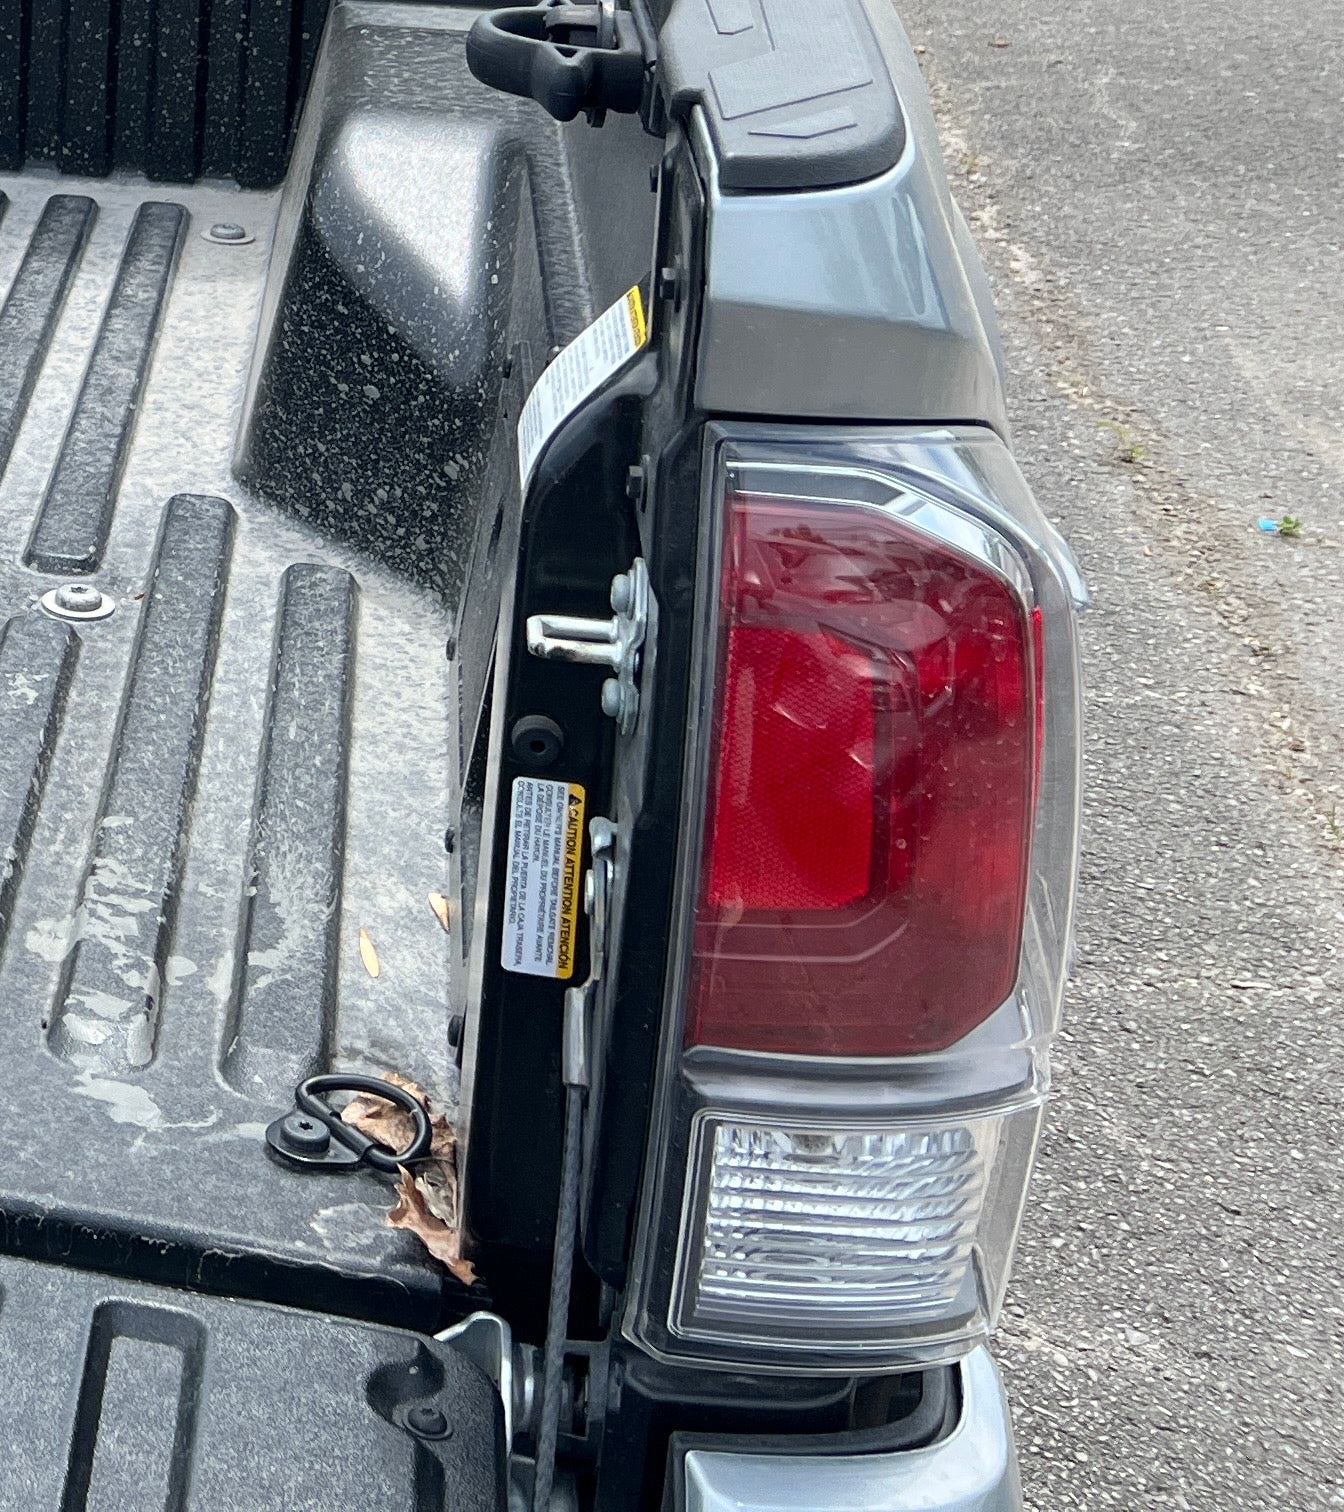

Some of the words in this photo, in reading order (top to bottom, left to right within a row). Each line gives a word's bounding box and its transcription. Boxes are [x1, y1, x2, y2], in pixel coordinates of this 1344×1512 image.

[525, 782, 533, 805] ANTES
[537, 783, 544, 792] LA
[524, 807, 531, 817] DE
[515, 820, 522, 828] EL
[535, 825, 541, 835] DU
[566, 809, 579, 855] CAUTION
[543, 829, 550, 837] LE
[513, 831, 521, 859] MANUAL
[553, 837, 561, 866] MANUAL
[522, 852, 528, 860] LA
[541, 840, 550, 869] MANUEL
[540, 871, 547, 881] DU
[550, 867, 559, 897] BEFORE
[562, 857, 574, 915] ATTENTION
[519, 891, 526, 901] DE
[518, 903, 525, 911] LA
[549, 899, 557, 930] TAILGATE
[517, 913, 525, 930] CAJA
[559, 917, 570, 969] ATENCIÓN
